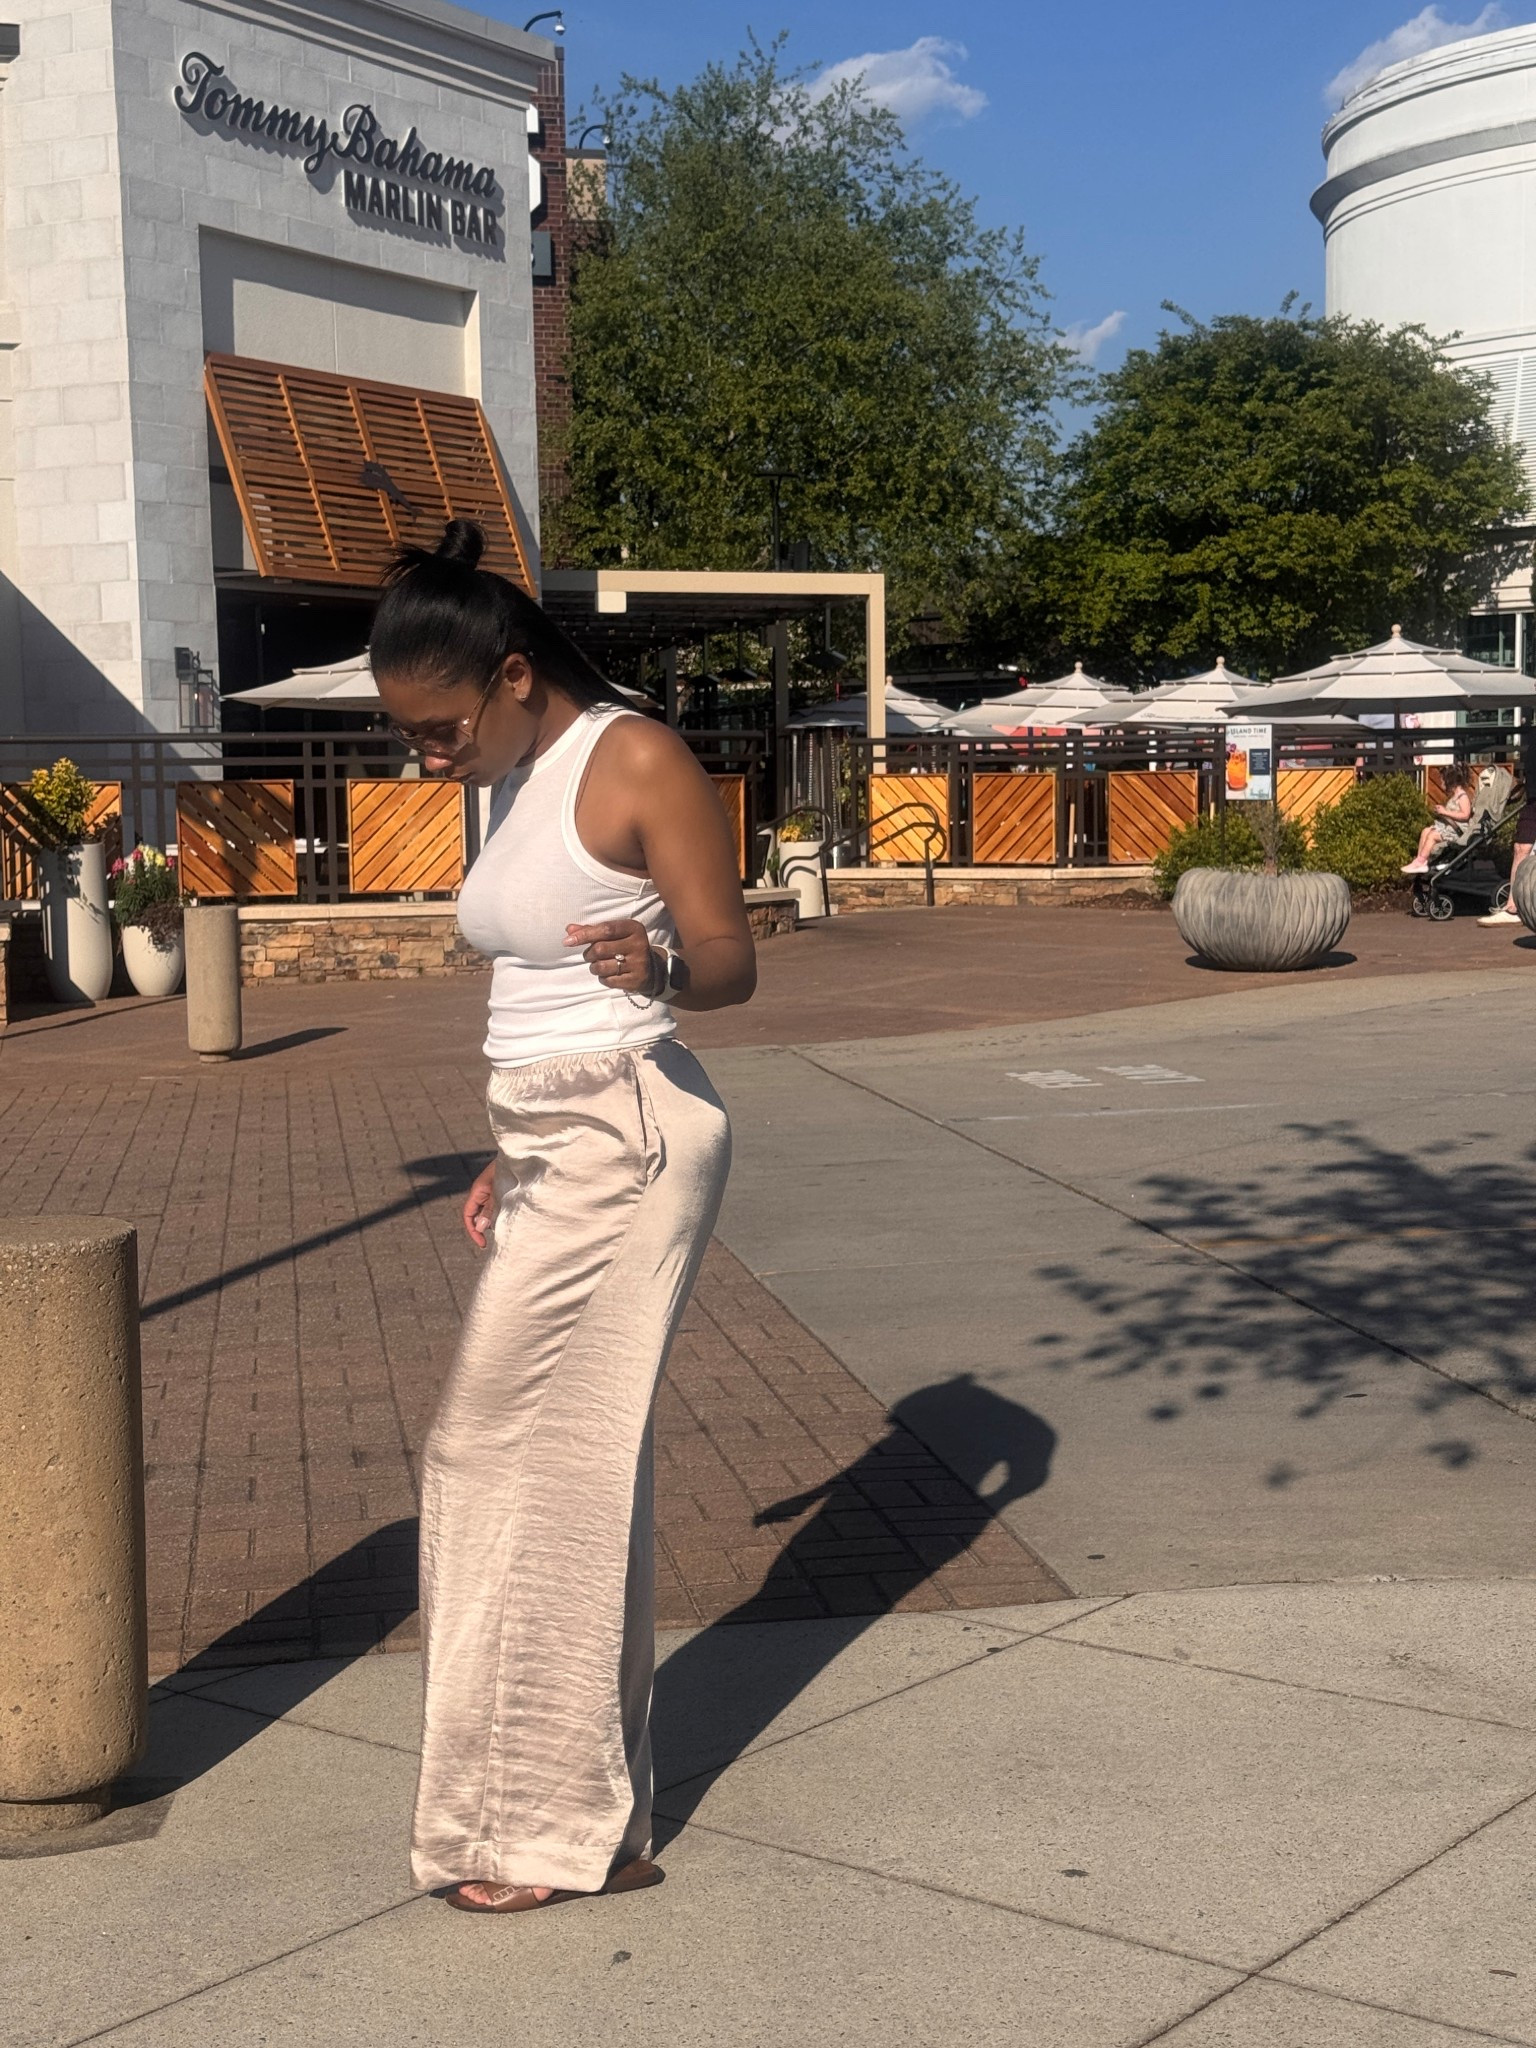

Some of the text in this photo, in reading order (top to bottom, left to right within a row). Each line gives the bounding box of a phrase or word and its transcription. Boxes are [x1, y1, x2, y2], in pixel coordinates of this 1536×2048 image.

[174, 51, 497, 198] Tommy Bahama
[342, 169, 498, 246] MARLIN BAR
